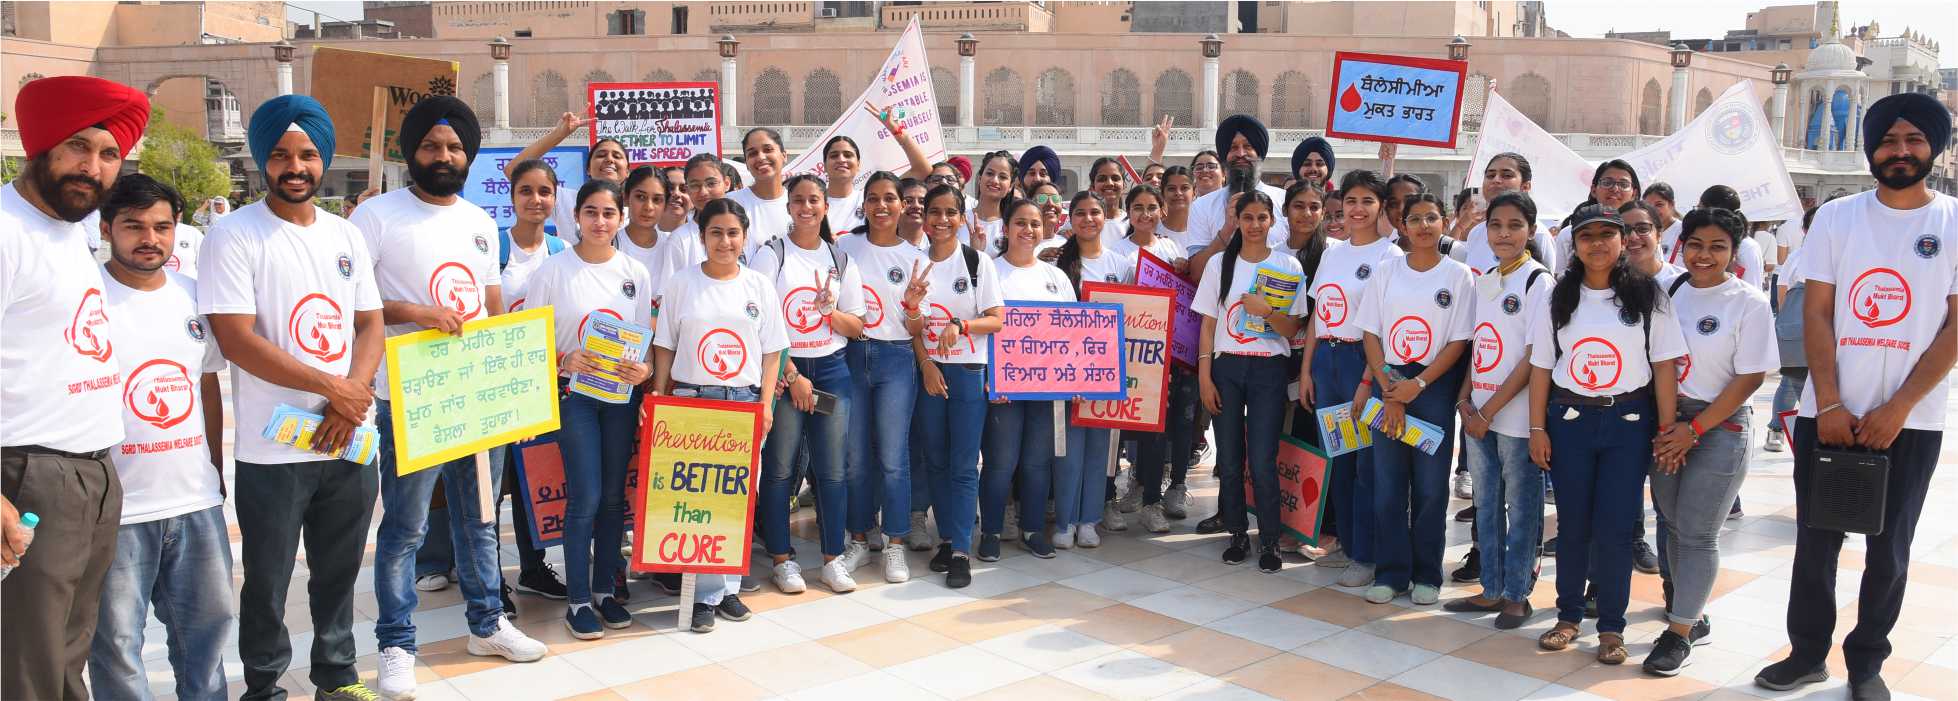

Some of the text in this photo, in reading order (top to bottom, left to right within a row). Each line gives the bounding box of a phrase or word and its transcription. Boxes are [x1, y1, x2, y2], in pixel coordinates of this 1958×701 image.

[1363, 102, 1436, 121] ਮੁਕਤ ਭਾਰਤ
[660, 133, 674, 146] TO
[676, 133, 706, 146] LIMIT
[877, 127, 890, 140] GE
[912, 131, 929, 145] TED
[650, 147, 691, 160] SPREAD
[429, 341, 449, 358] ਹਰ
[1002, 340, 1016, 354] ਦਾ
[1002, 362, 1115, 381] ਵਿਆਹ ਅਤੇ ਸੰਤਾਨ
[1091, 398, 1143, 420] CURE
[653, 420, 750, 453] Prevention
[653, 472, 665, 490] is
[671, 461, 749, 495] BETTER
[673, 501, 711, 525] than
[658, 532, 727, 564] CURE
